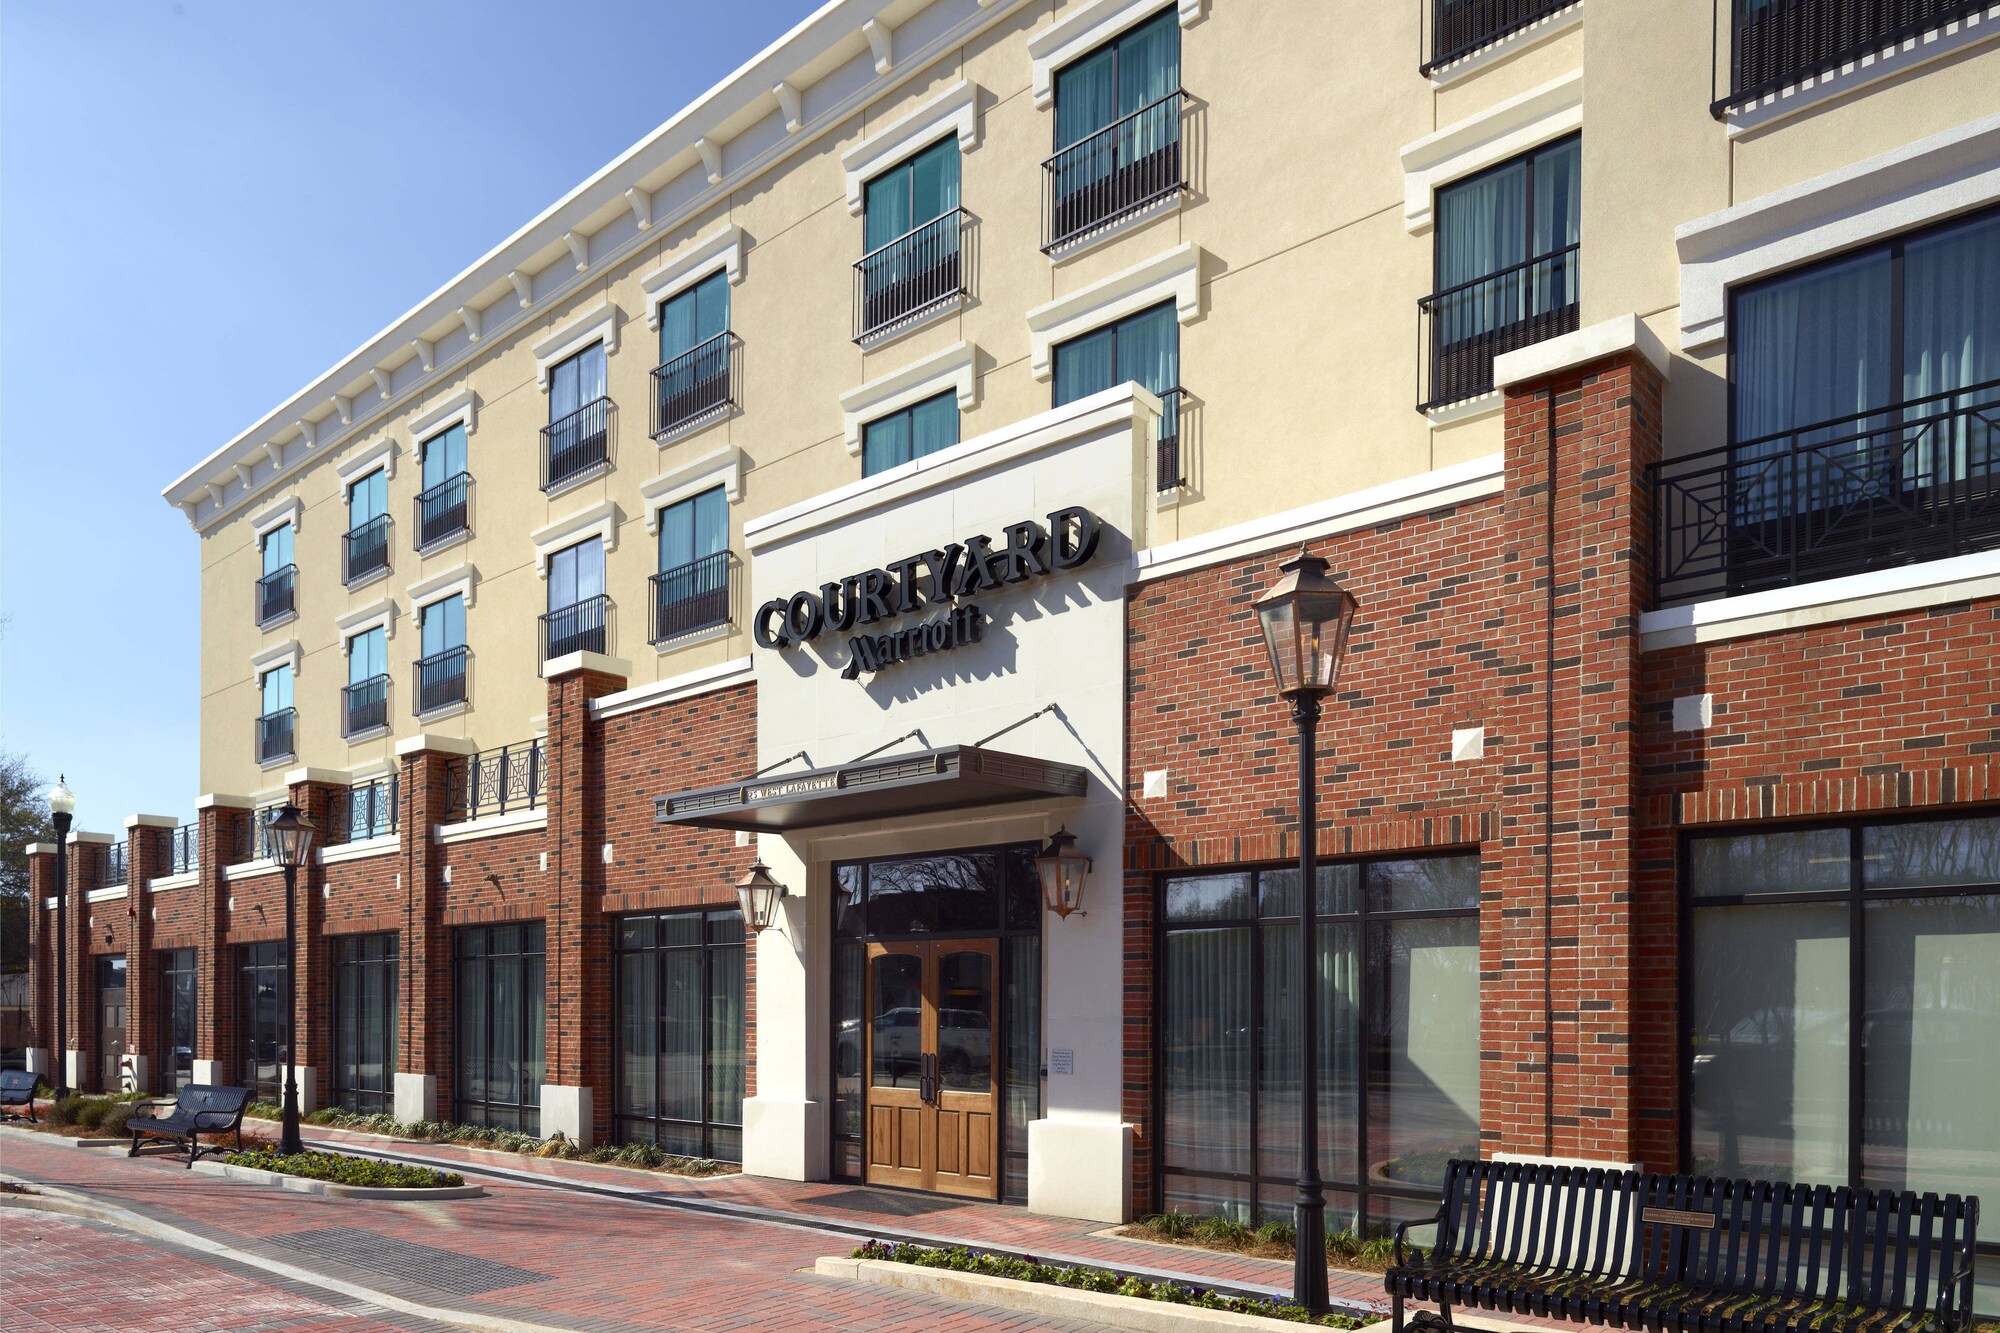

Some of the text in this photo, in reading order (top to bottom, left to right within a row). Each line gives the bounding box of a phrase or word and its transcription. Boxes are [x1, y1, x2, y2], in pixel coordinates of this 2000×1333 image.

[754, 506, 1101, 650] COURTYARD
[841, 603, 982, 680] Marriott
[760, 786, 783, 797] WEST
[786, 777, 837, 793] LAFAYETTE
